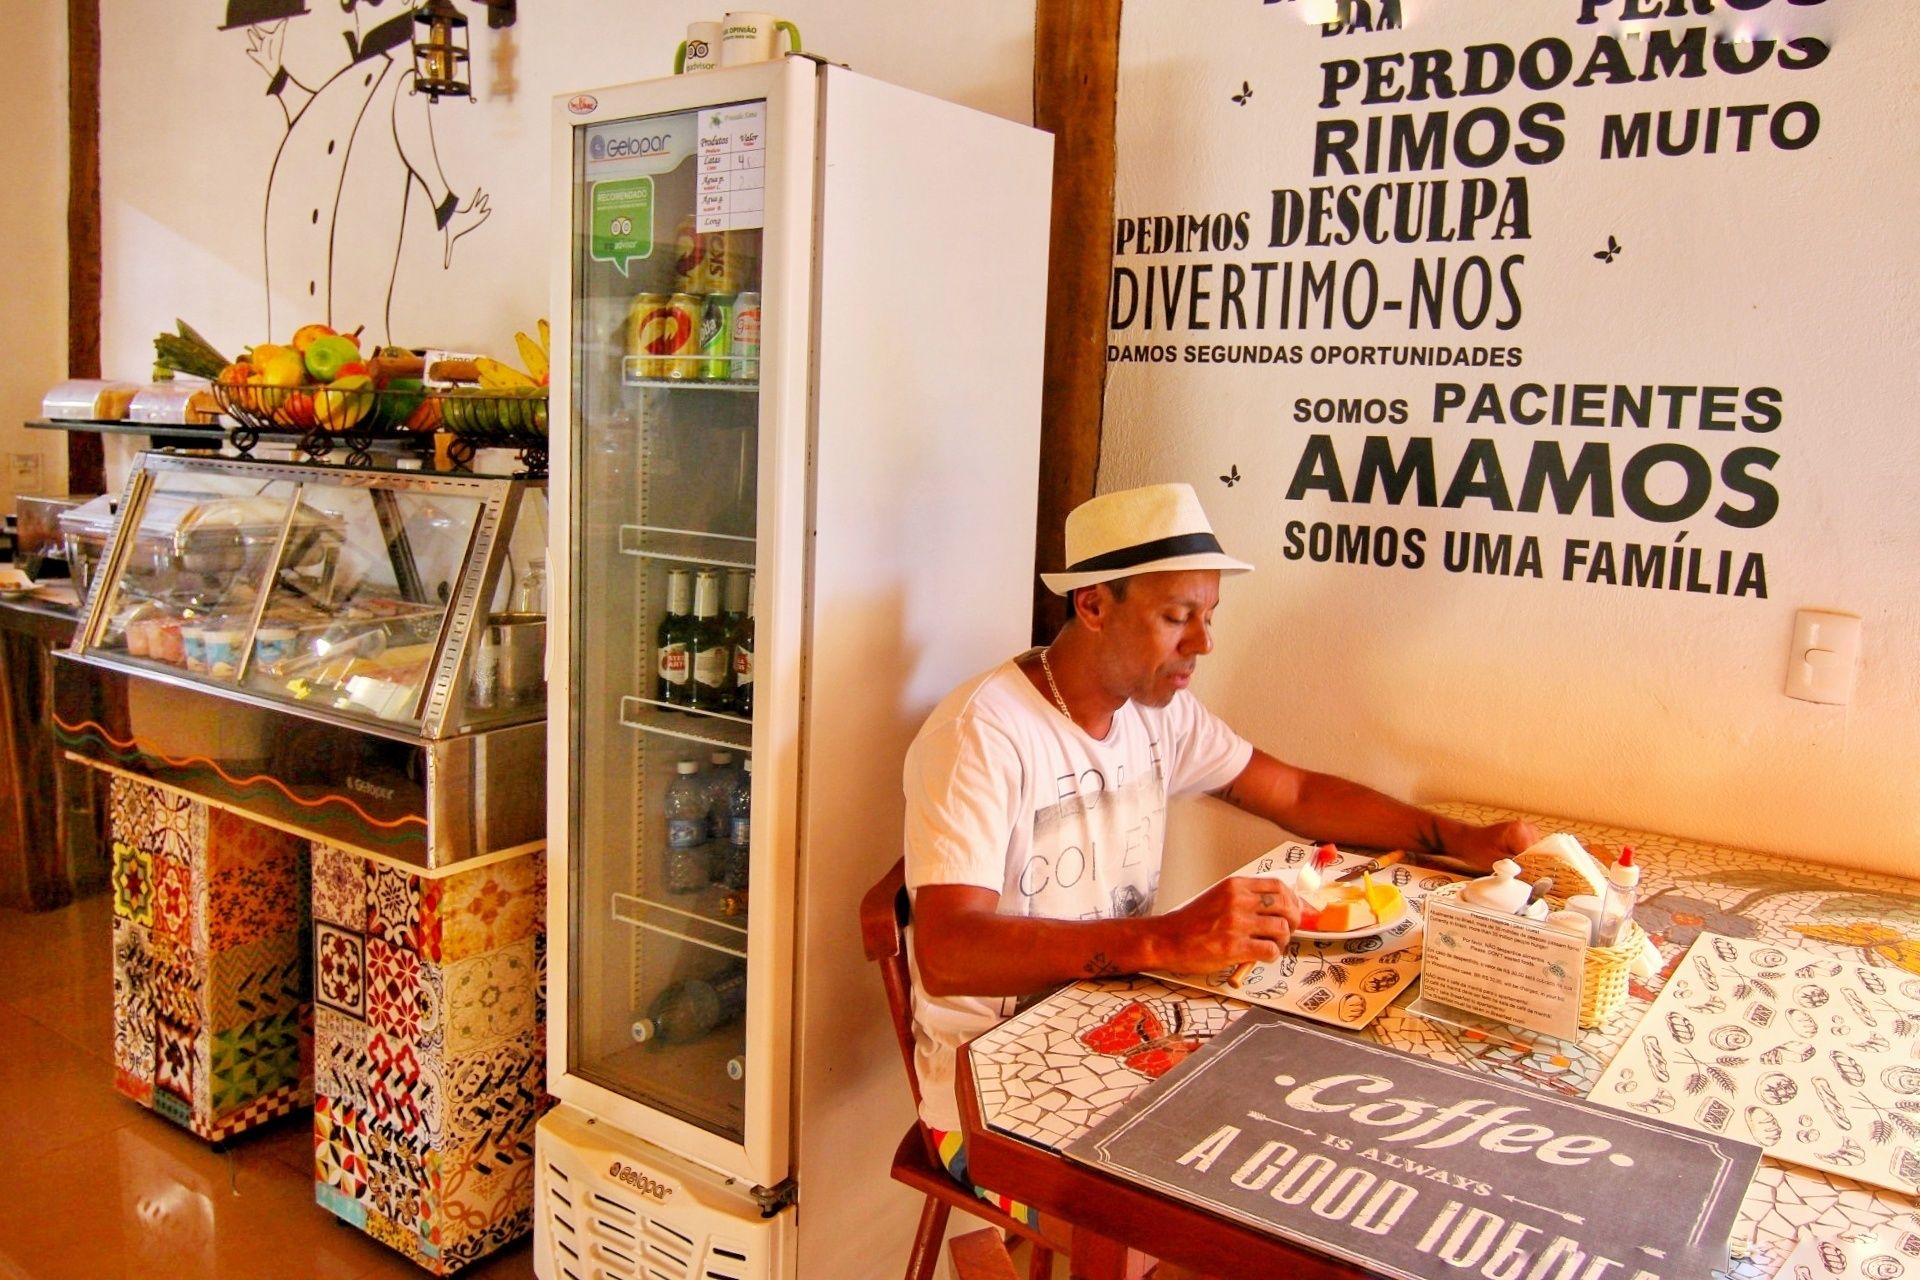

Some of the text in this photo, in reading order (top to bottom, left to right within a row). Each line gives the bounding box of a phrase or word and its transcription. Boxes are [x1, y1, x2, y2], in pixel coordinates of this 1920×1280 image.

[1319, 27, 1830, 108] PERDOAMOS
[607, 134, 671, 157] Gelopar
[1314, 101, 1820, 176] RIMOS MUITO
[597, 188, 647, 202] RECOMENDADO
[1115, 177, 1531, 255] PEDIMOS DESCULPA
[709, 231, 725, 277] SKO
[1111, 255, 1524, 330] DIVERTIMO-NOS
[1107, 345, 1521, 367] DAMOS SEGUNDAS OPORTUNIDADES
[1294, 384, 1782, 433] SOMOS PACIENTES
[1285, 435, 1780, 528] AMAMOS
[1284, 521, 1767, 598] SOMOS UMA FAMÍLIA
[1285, 1074, 1612, 1167] Coffee
[1175, 1124, 1242, 1174] A
[1230, 1140, 1420, 1236] GOOD
[1320, 1132, 1493, 1197] IS ALWAYS
